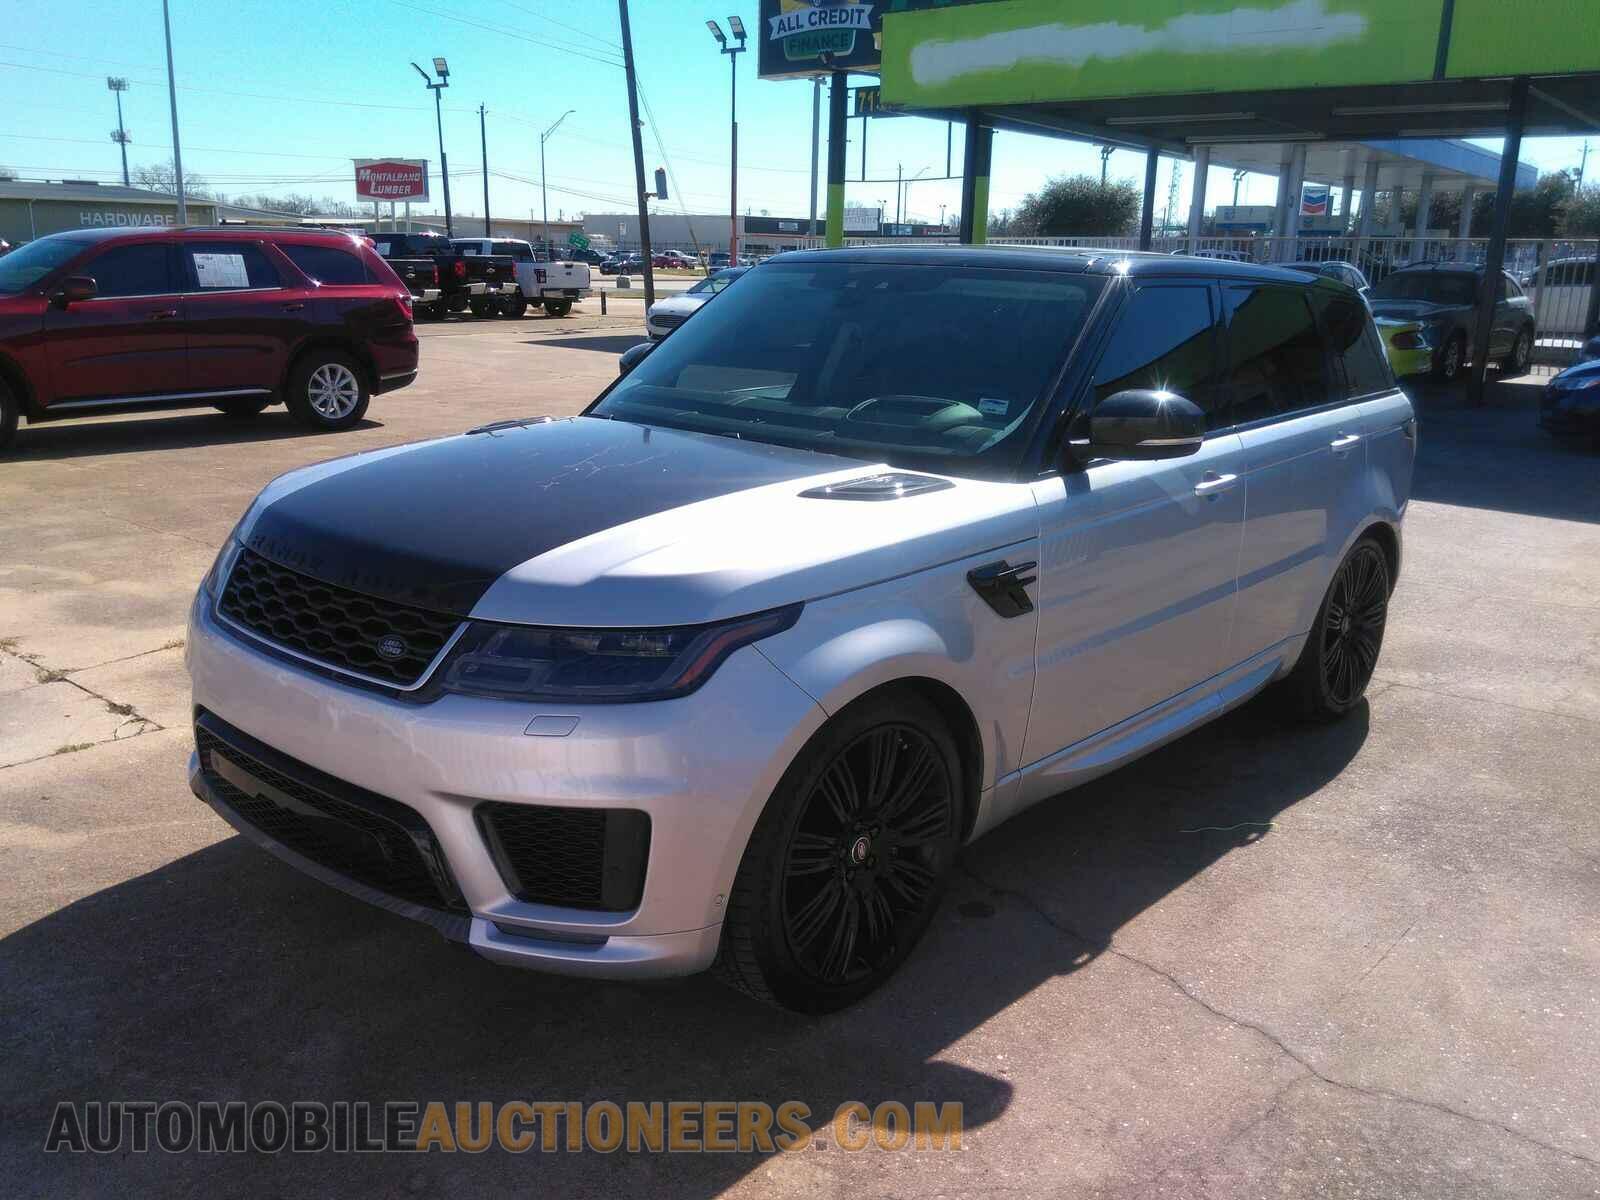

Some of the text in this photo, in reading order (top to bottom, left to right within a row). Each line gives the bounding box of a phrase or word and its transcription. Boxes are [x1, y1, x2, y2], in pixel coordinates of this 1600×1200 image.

[777, 8, 865, 34] ALL CREDIT
[789, 31, 850, 52] FINANCE
[369, 181, 411, 194] LUMBER
[79, 211, 175, 227] HARDWARE
